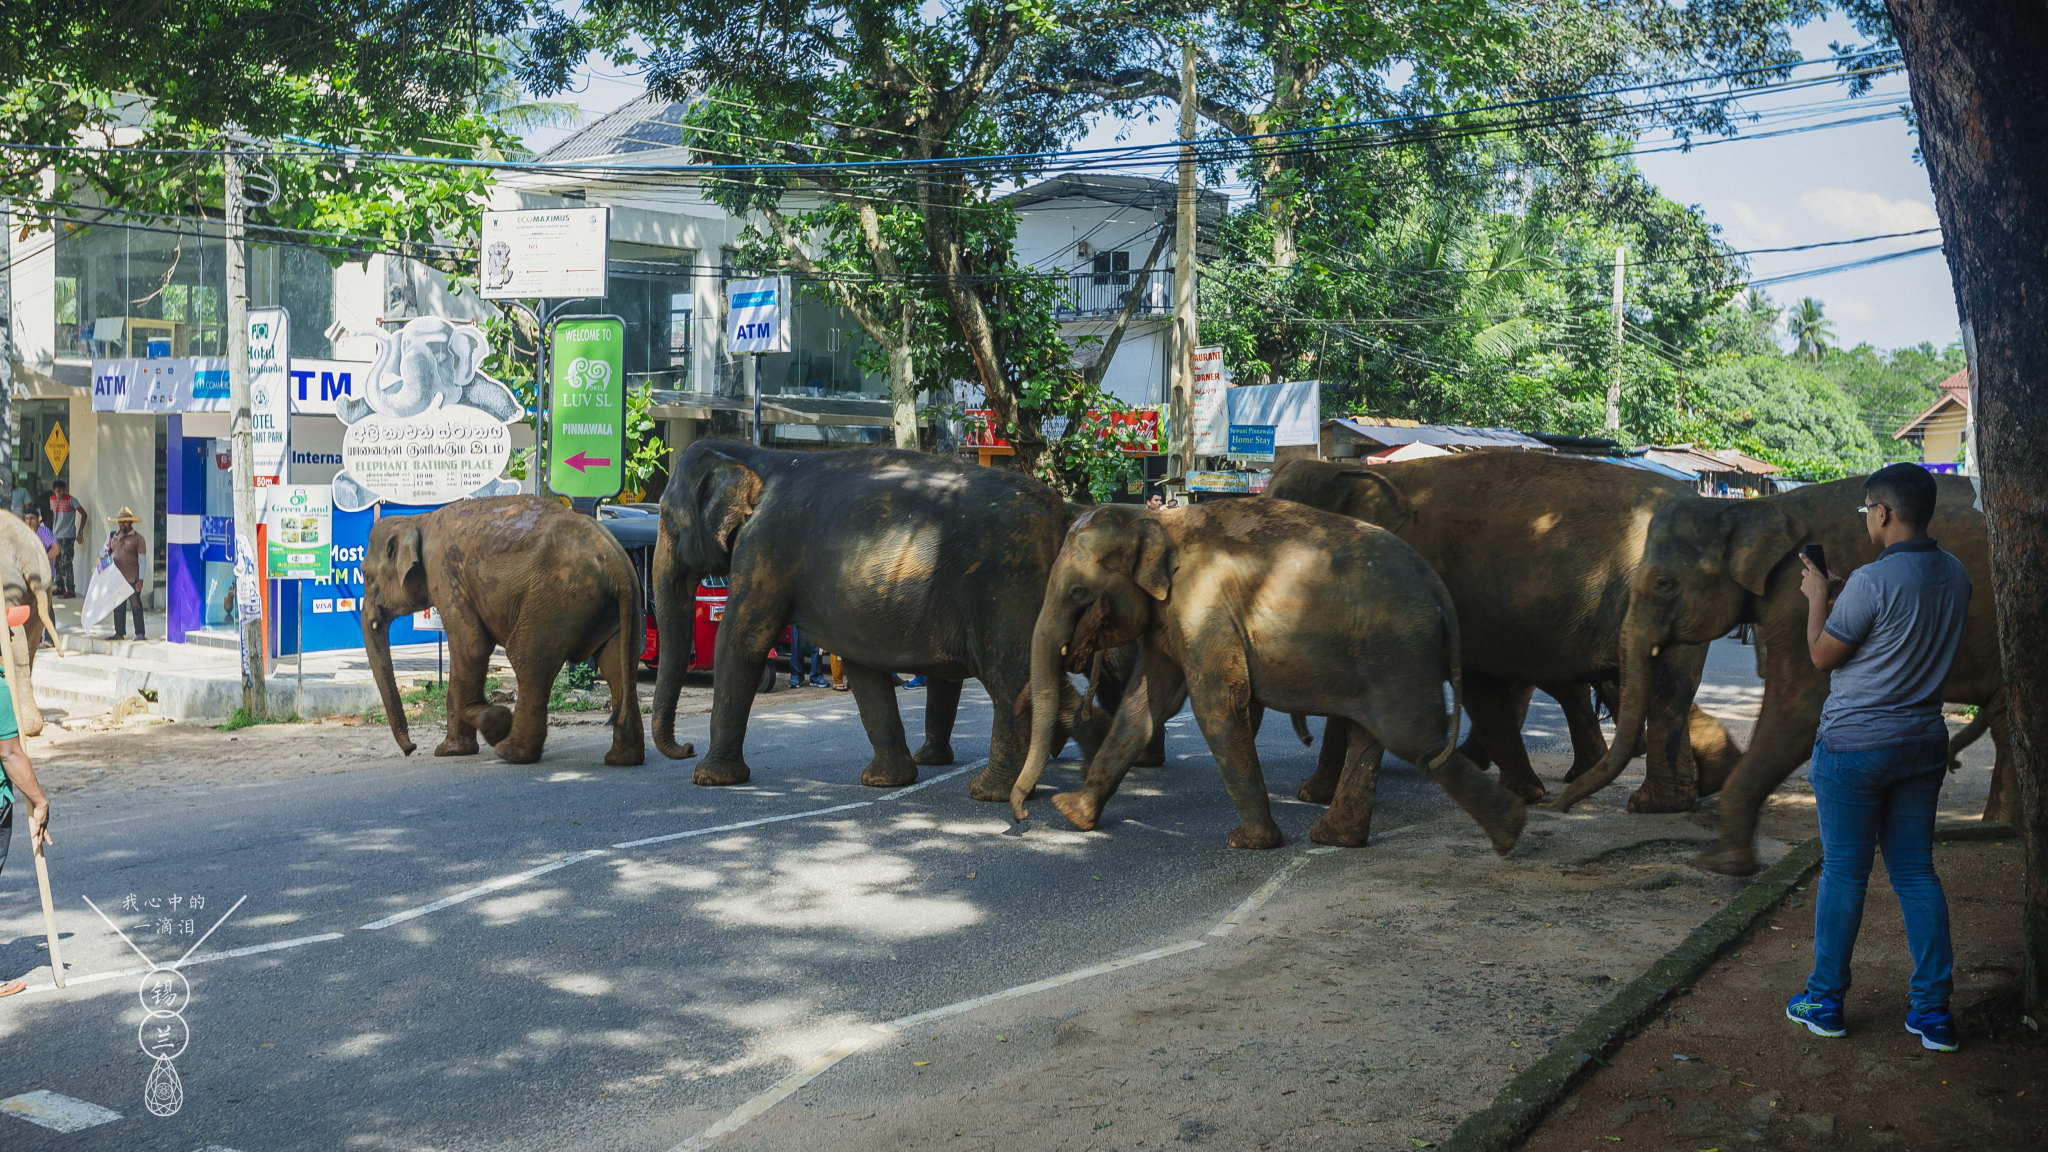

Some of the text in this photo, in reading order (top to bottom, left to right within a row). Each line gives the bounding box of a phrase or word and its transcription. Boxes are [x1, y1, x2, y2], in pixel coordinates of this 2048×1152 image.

[517, 214, 570, 223] ECOMAXIMUS
[566, 328, 612, 342] WELCOME TO
[736, 322, 770, 340] ATM
[94, 375, 126, 396] ATM
[562, 394, 612, 407] LUV SL
[562, 423, 612, 436] PINNAWALA
[268, 432, 283, 443] PARK
[1232, 435, 1271, 446] Home Stay
[356, 460, 494, 472] ELEPHANT BATHING PLACE
[272, 504, 328, 513] Green Land
[316, 602, 332, 610] VISA
